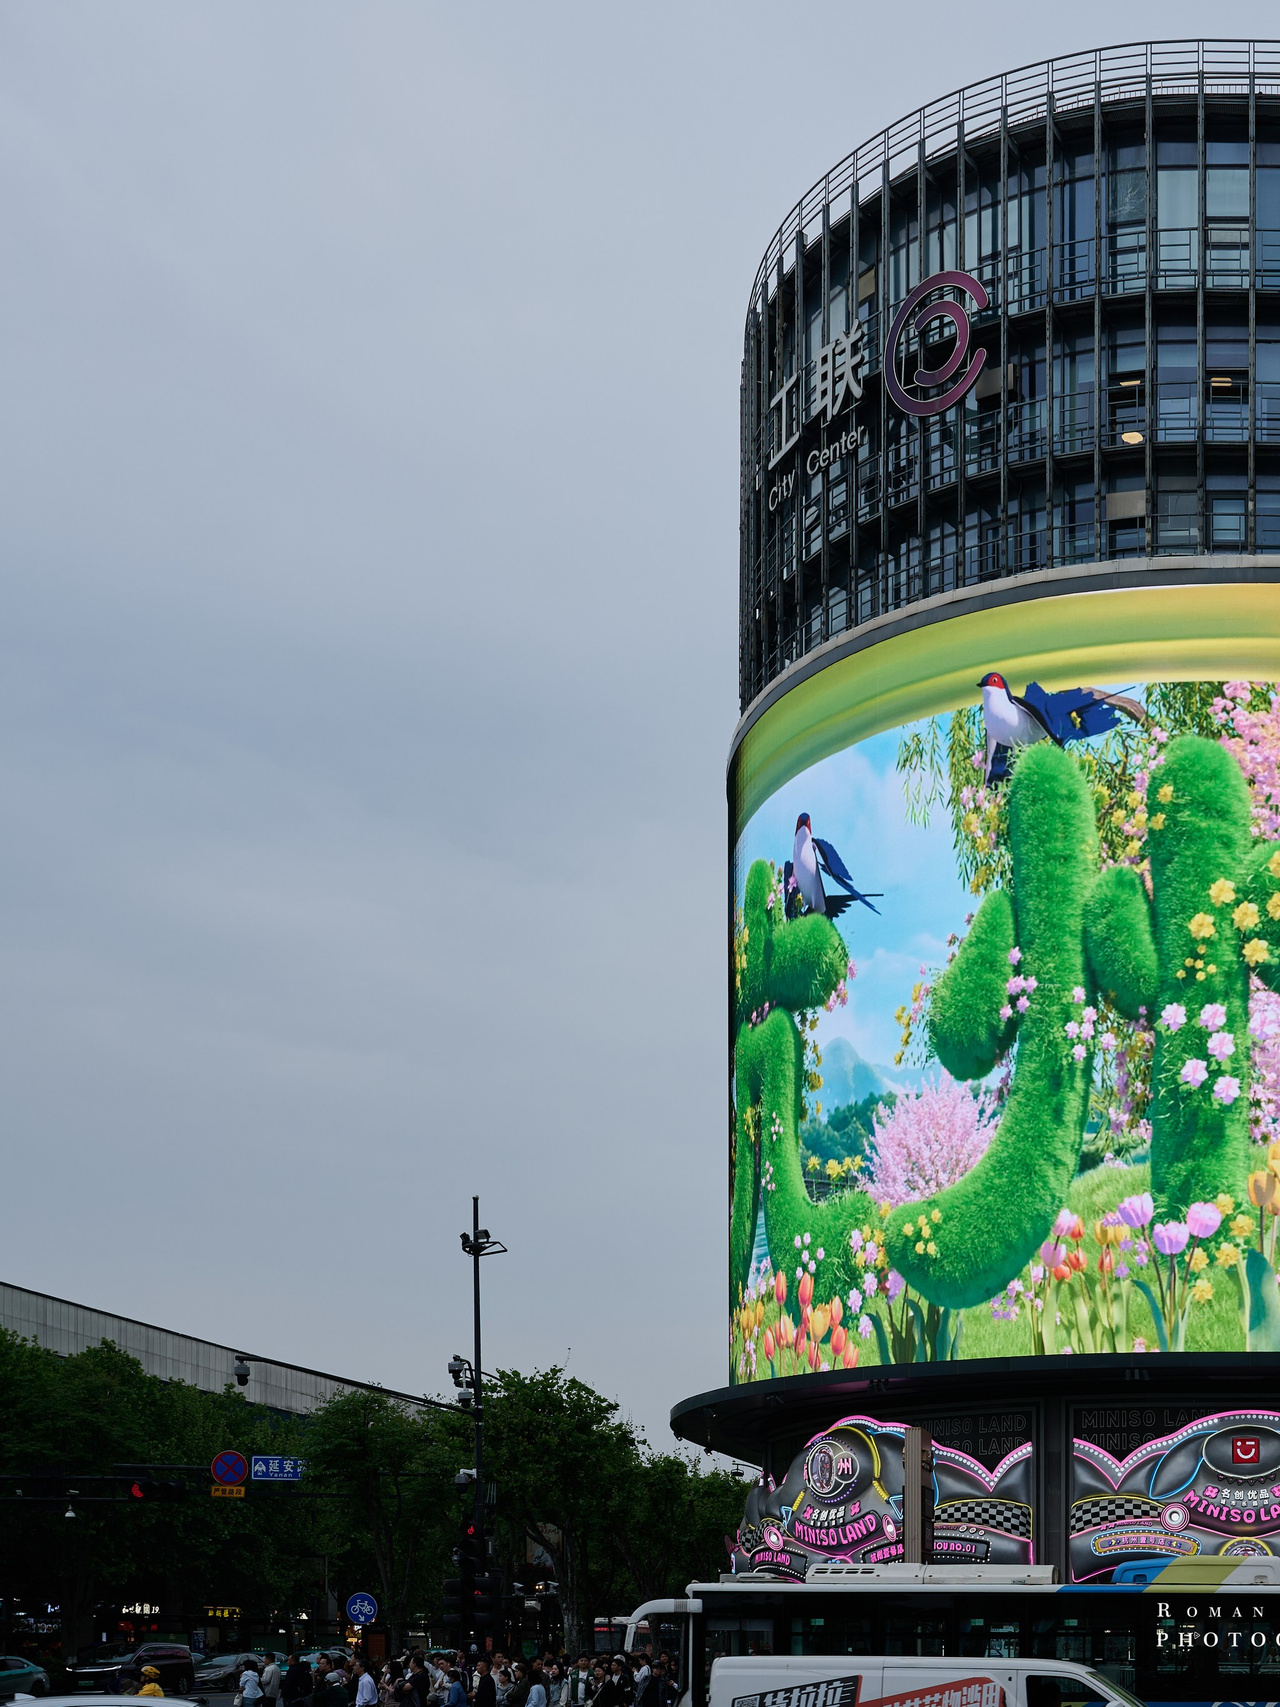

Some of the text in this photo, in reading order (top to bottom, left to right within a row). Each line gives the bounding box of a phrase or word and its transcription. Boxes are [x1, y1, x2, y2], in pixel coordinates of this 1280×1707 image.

[768, 318, 865, 470] 工联
[768, 424, 867, 512] City Center
[979, 1415, 1027, 1433] LAND
[1081, 1409, 1218, 1428] MINISO LAN
[1182, 1489, 1257, 1524] MINISO
[1221, 1488, 1269, 1500] 名创优品
[794, 1514, 877, 1546] MINISO LAND
[773, 1552, 791, 1566] LAND
